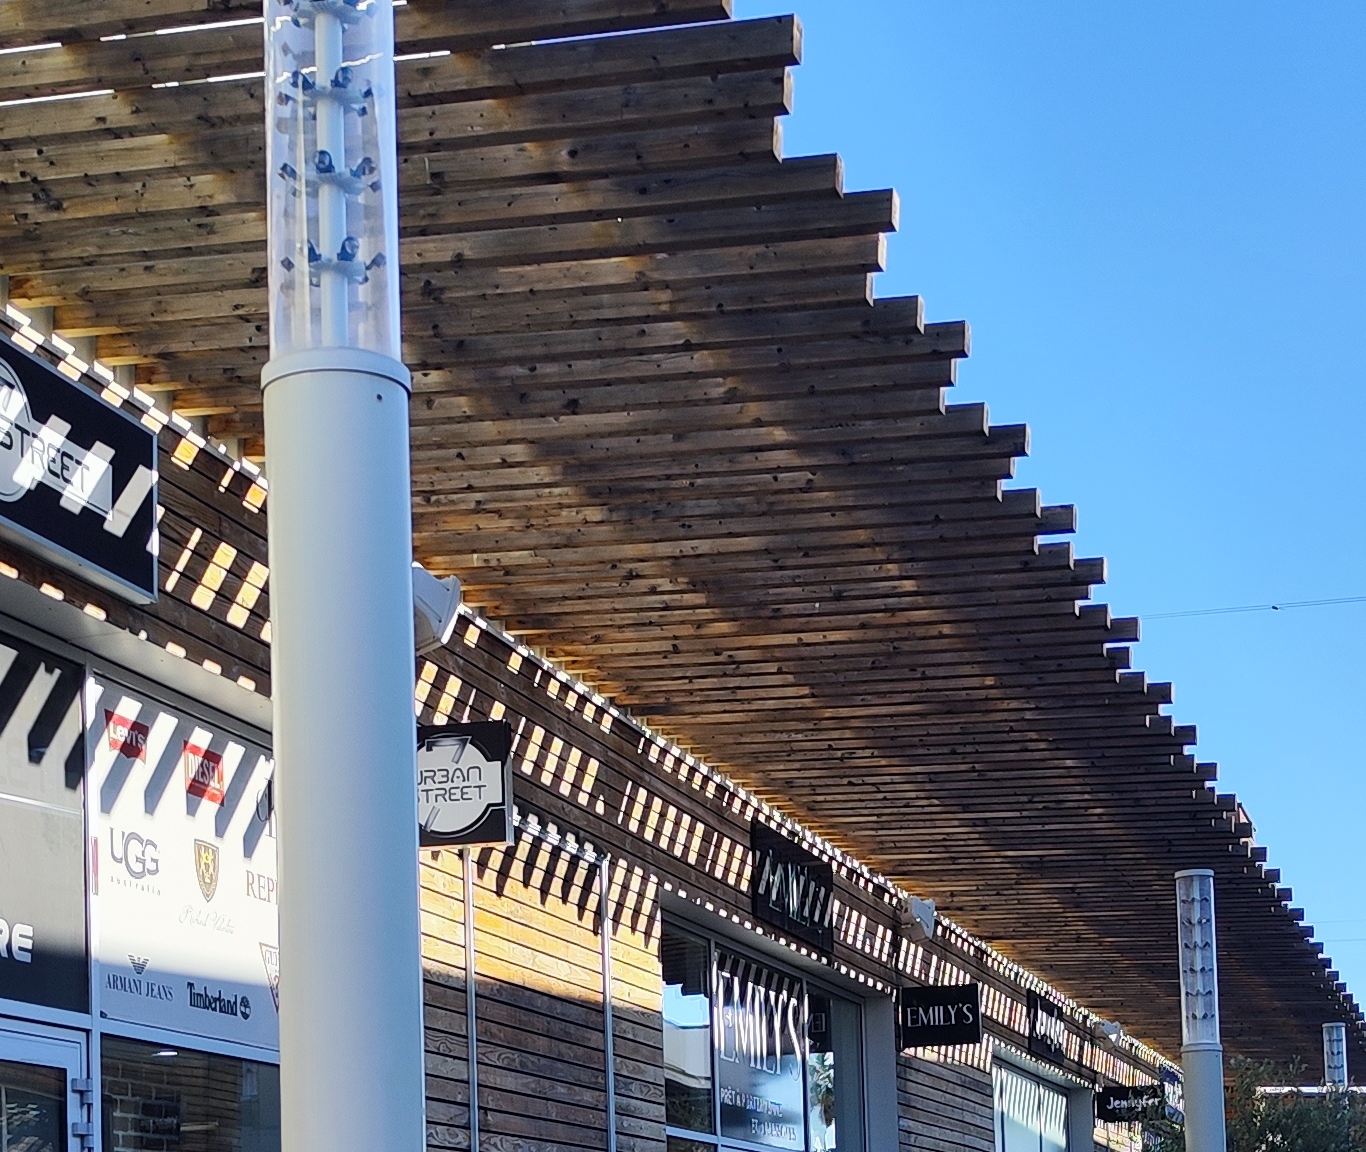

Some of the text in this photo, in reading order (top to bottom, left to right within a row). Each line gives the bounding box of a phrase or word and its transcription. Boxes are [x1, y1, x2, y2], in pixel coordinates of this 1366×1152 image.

[188, 752, 221, 789] DIESEL
[417, 784, 487, 804] TREET
[109, 827, 160, 879] UGG
[105, 973, 174, 1002] ARMANI JEANS
[186, 981, 238, 1018] Timberland
[906, 1003, 974, 1028] EMILY'S
